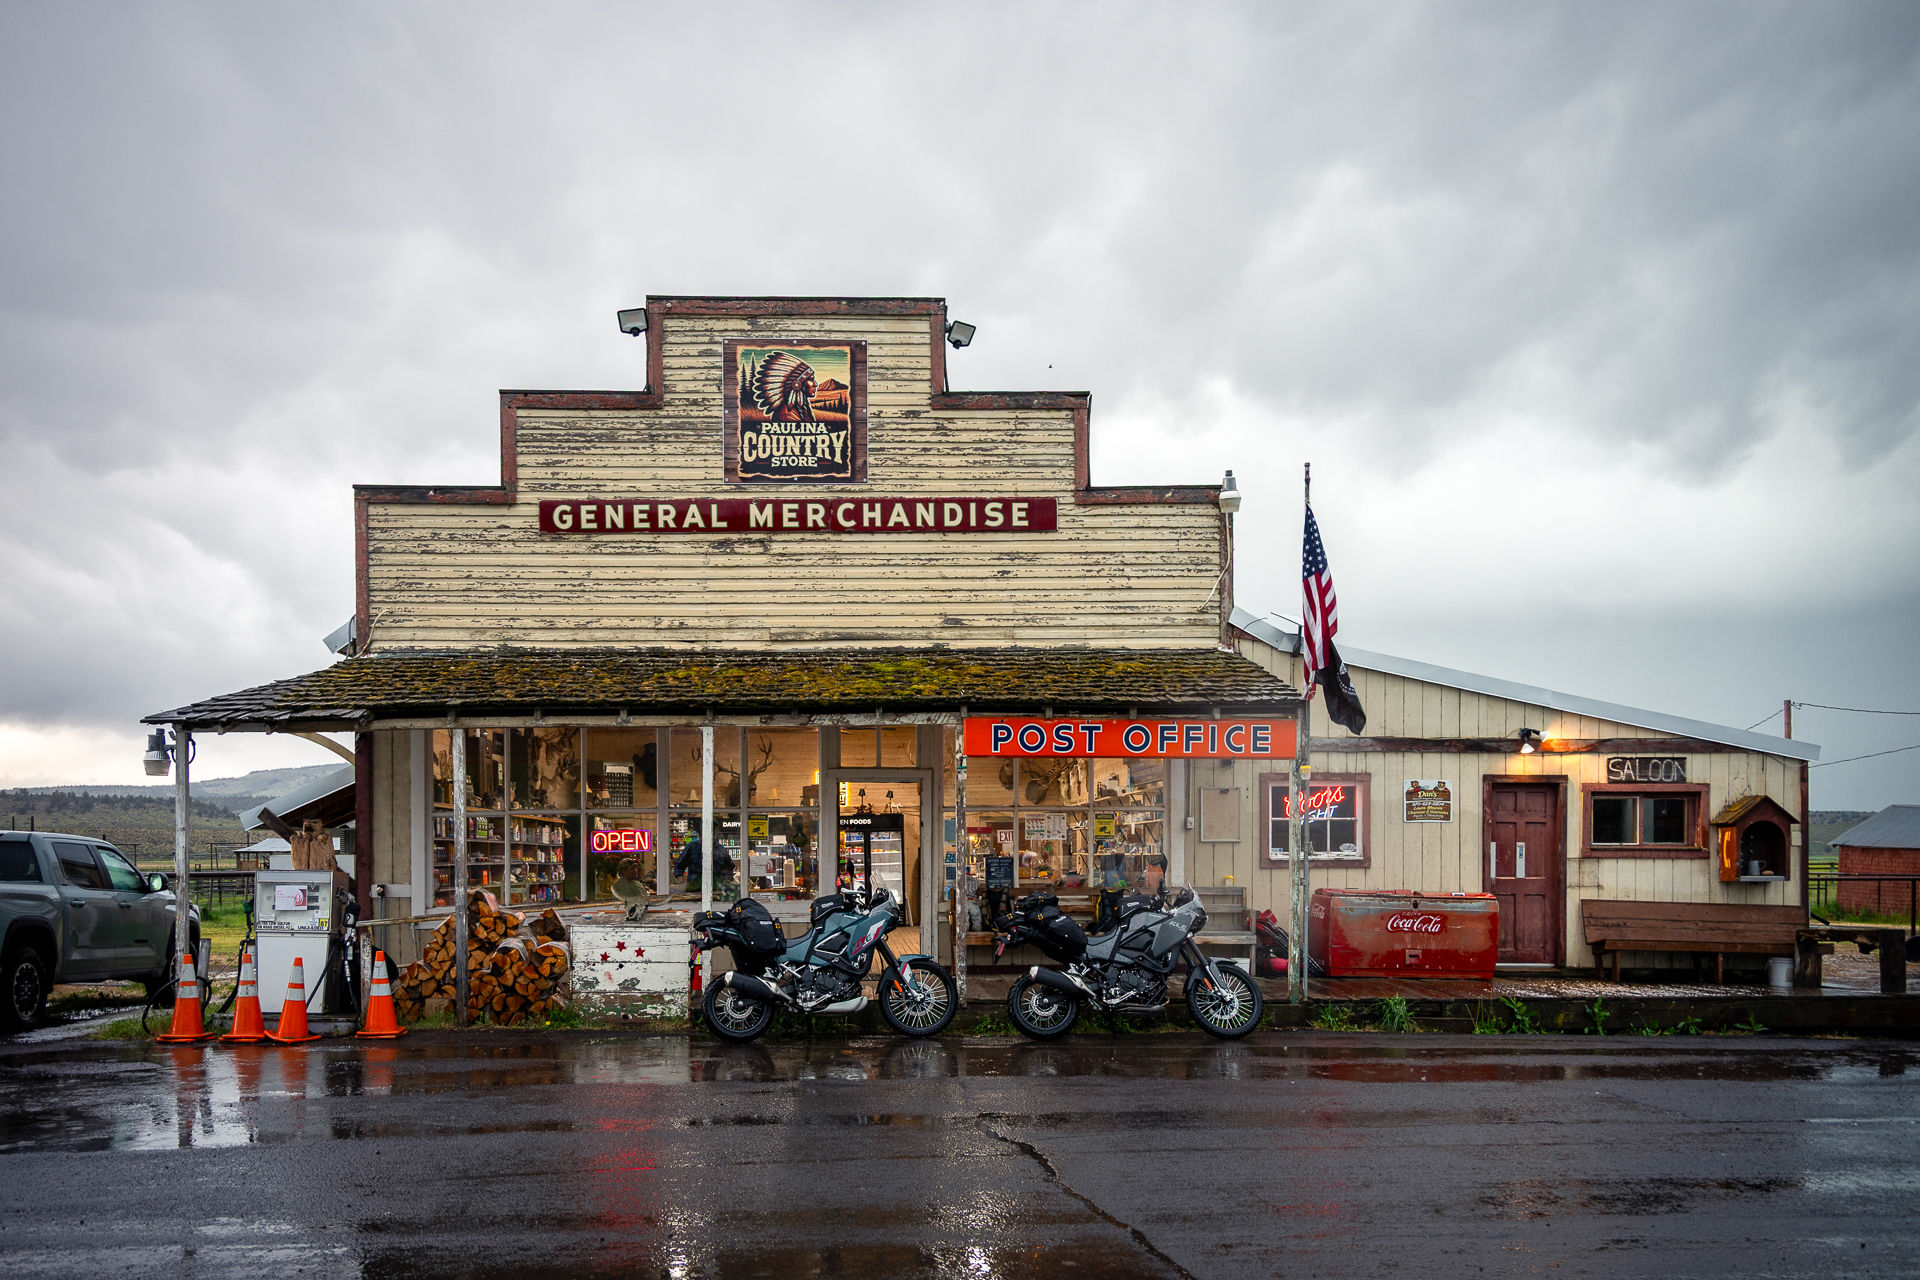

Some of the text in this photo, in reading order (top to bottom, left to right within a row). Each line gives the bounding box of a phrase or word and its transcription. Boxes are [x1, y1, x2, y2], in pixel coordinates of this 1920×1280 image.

[761, 422, 828, 434] PAULINA
[743, 430, 847, 464] COUNTRY
[771, 456, 818, 467] STORE
[552, 502, 1029, 530] GENERAL MERCHANDISE
[991, 723, 1272, 754] POST OFFICE
[1608, 758, 1687, 782] SALOON
[593, 831, 648, 851] OPEN
[1169, 920, 1188, 930] KLE
